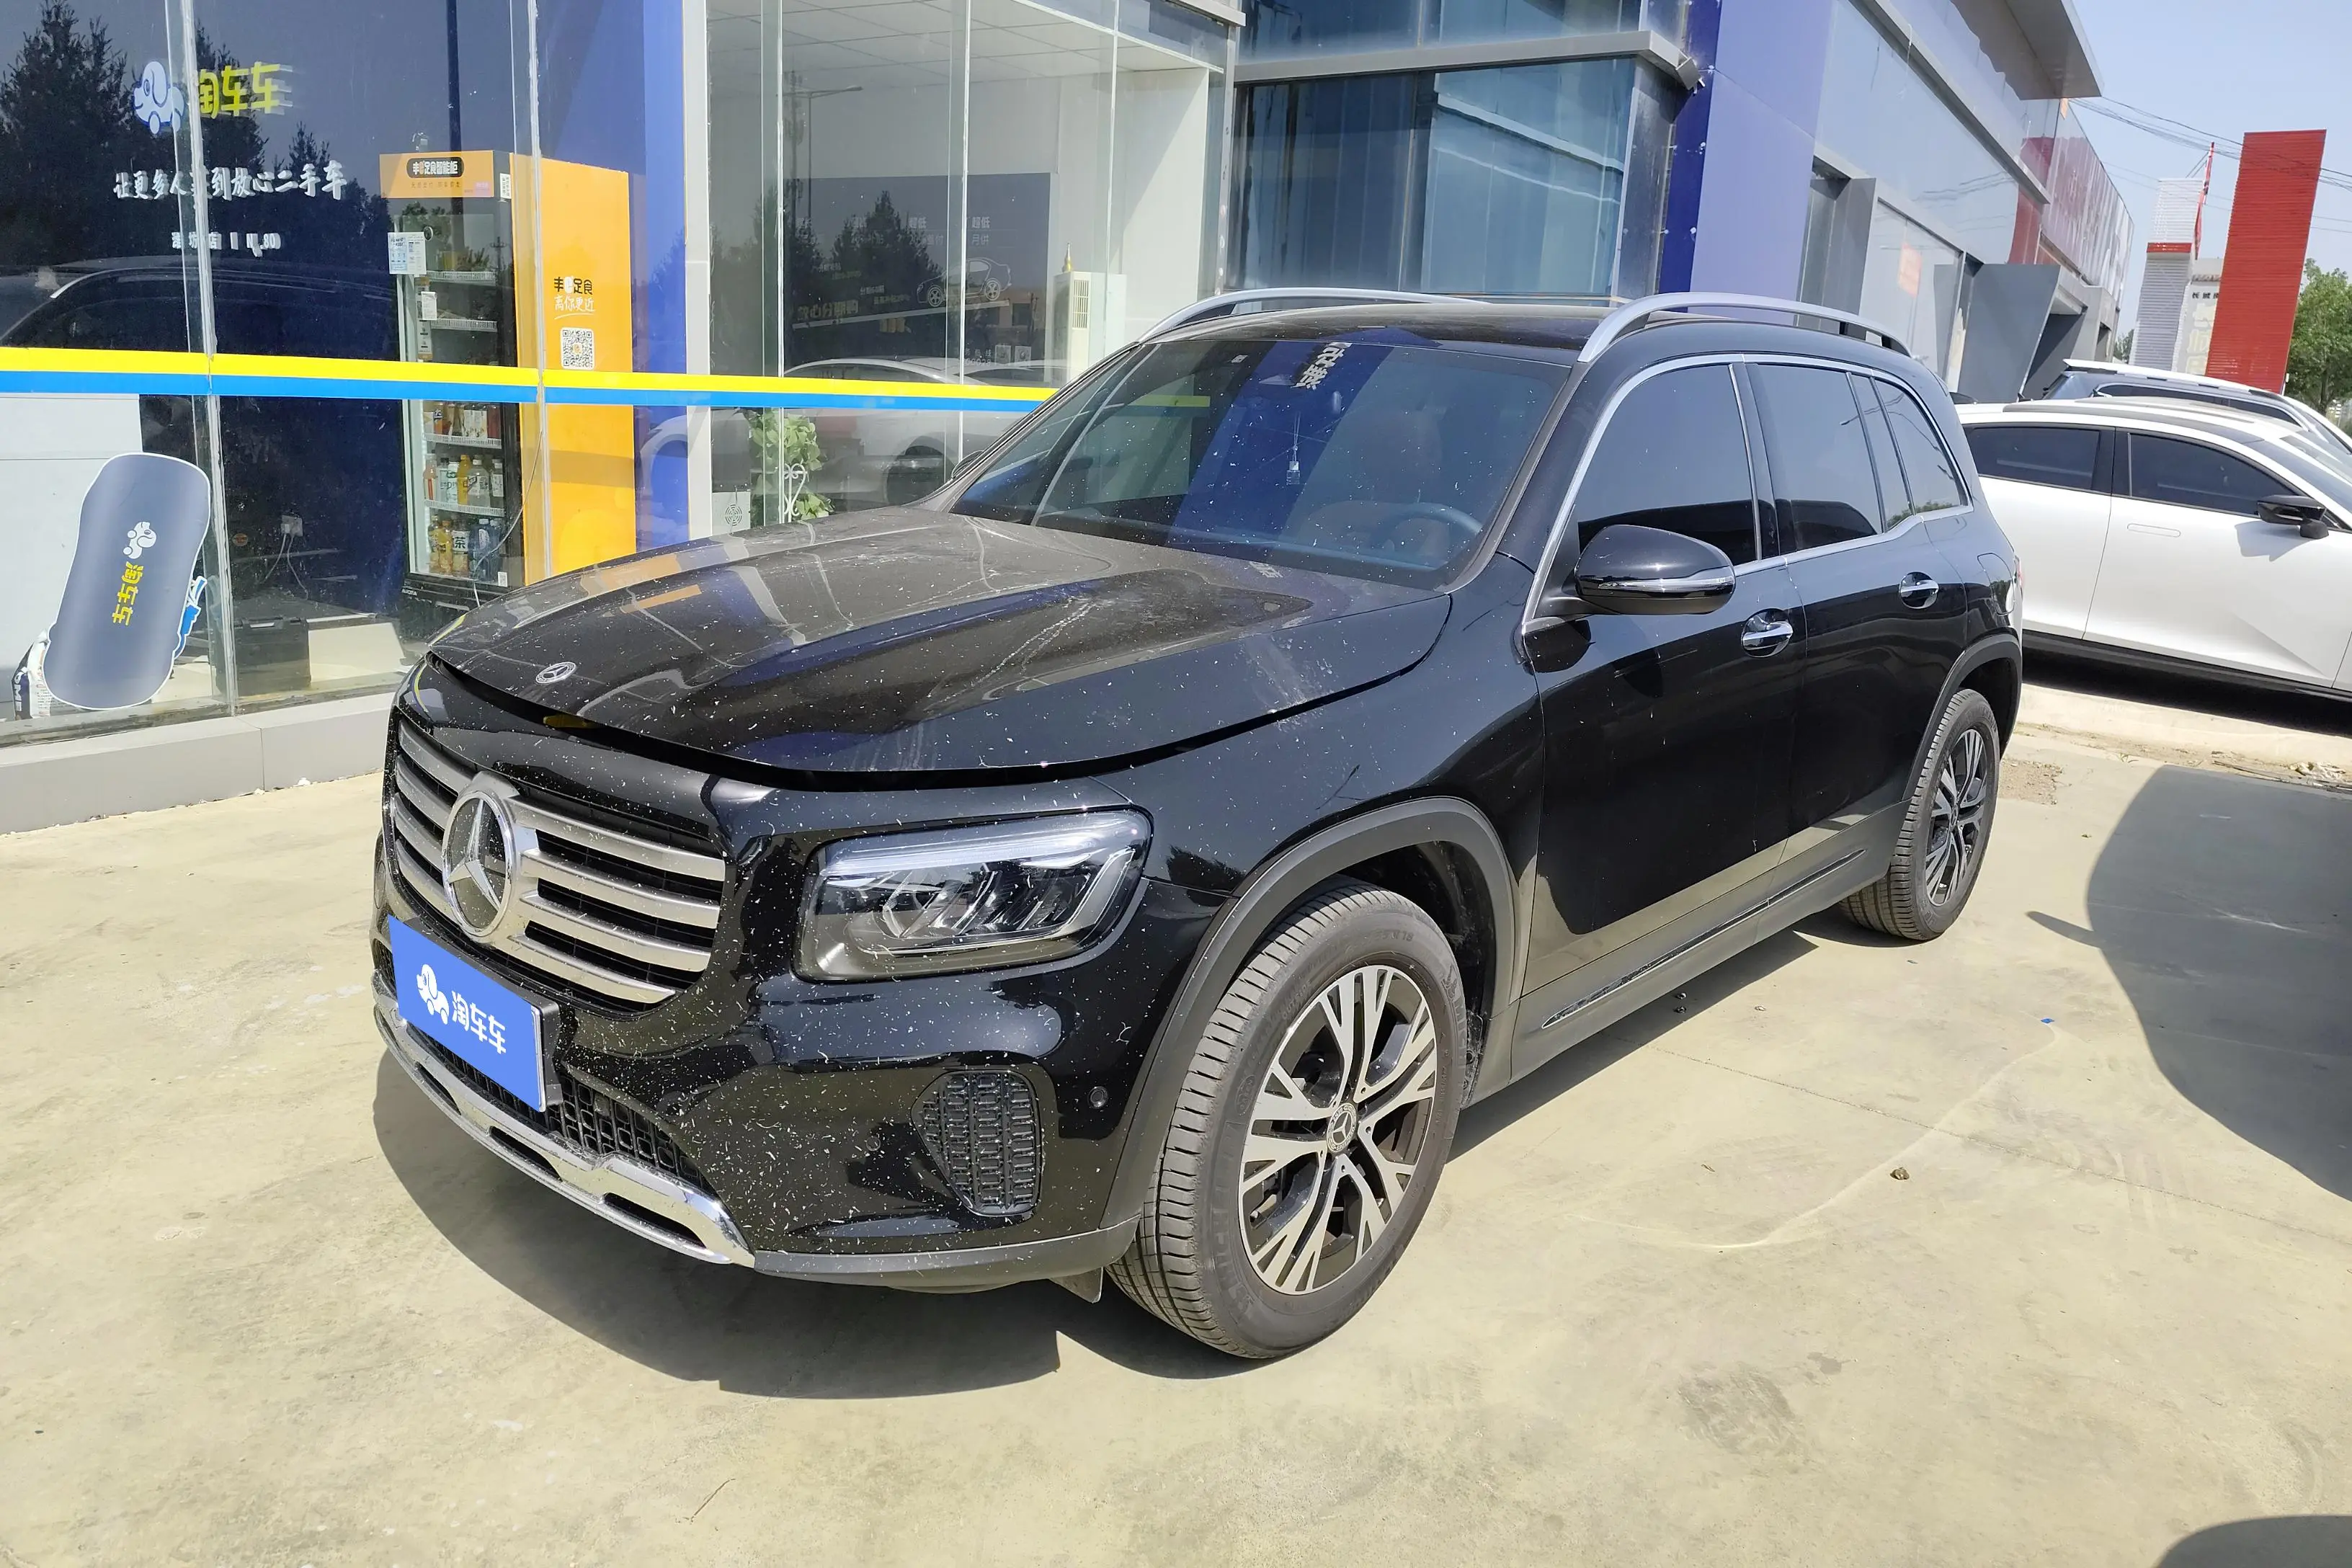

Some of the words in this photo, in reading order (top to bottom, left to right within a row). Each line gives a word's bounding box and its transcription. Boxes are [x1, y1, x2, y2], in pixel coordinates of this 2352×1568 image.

[455, 536, 466, 549] 茶
[112, 561, 144, 626] 淘车车
